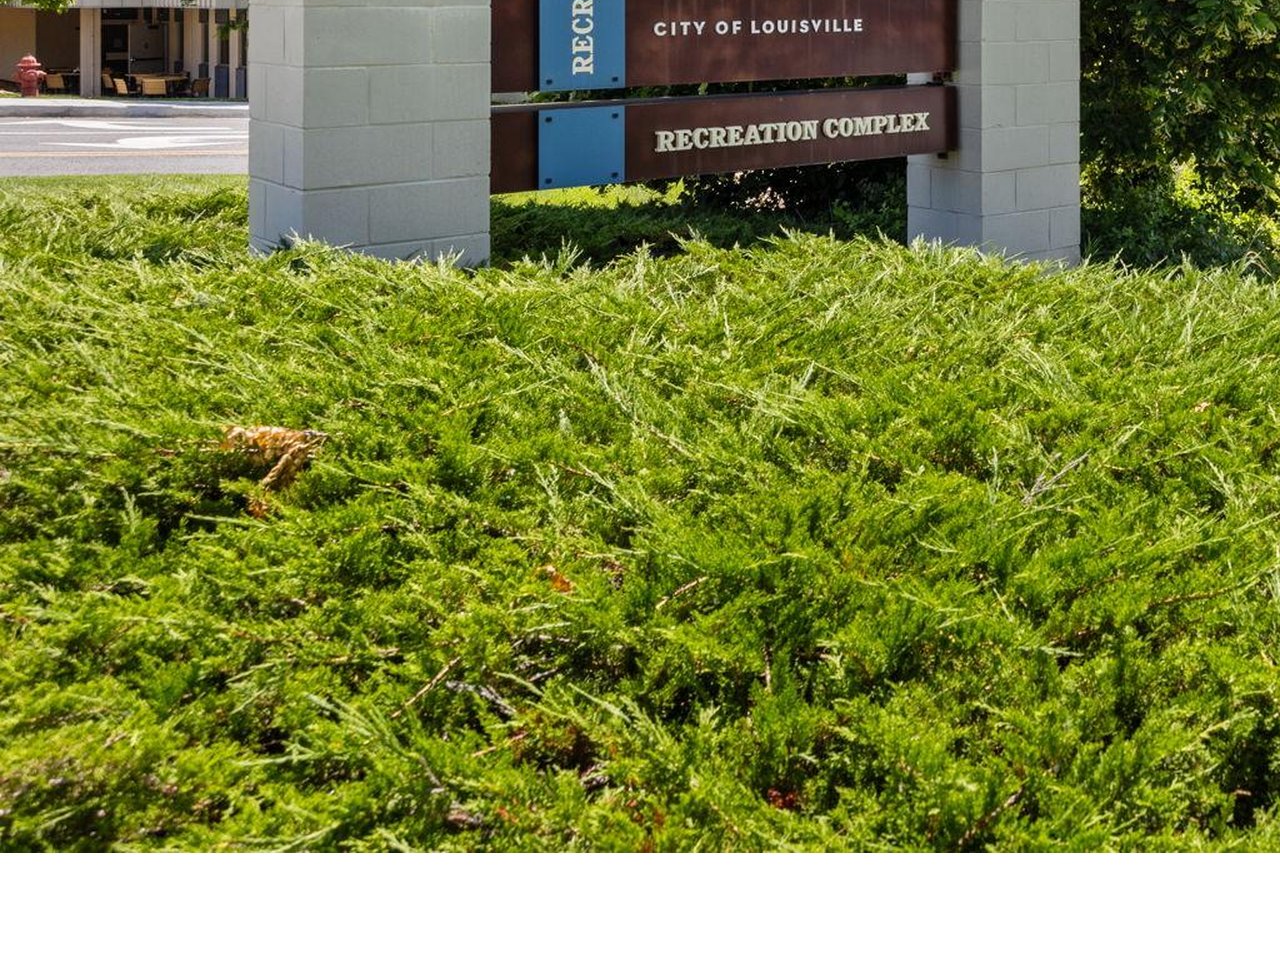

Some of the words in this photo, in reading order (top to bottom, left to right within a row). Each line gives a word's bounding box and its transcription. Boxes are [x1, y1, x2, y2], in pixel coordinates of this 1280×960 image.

[653, 21, 705, 37] CITY
[715, 20, 742, 36] OF
[751, 18, 863, 35] LOUISVILLE
[654, 120, 818, 153] RECREATION
[823, 112, 930, 139] COMPLEX
